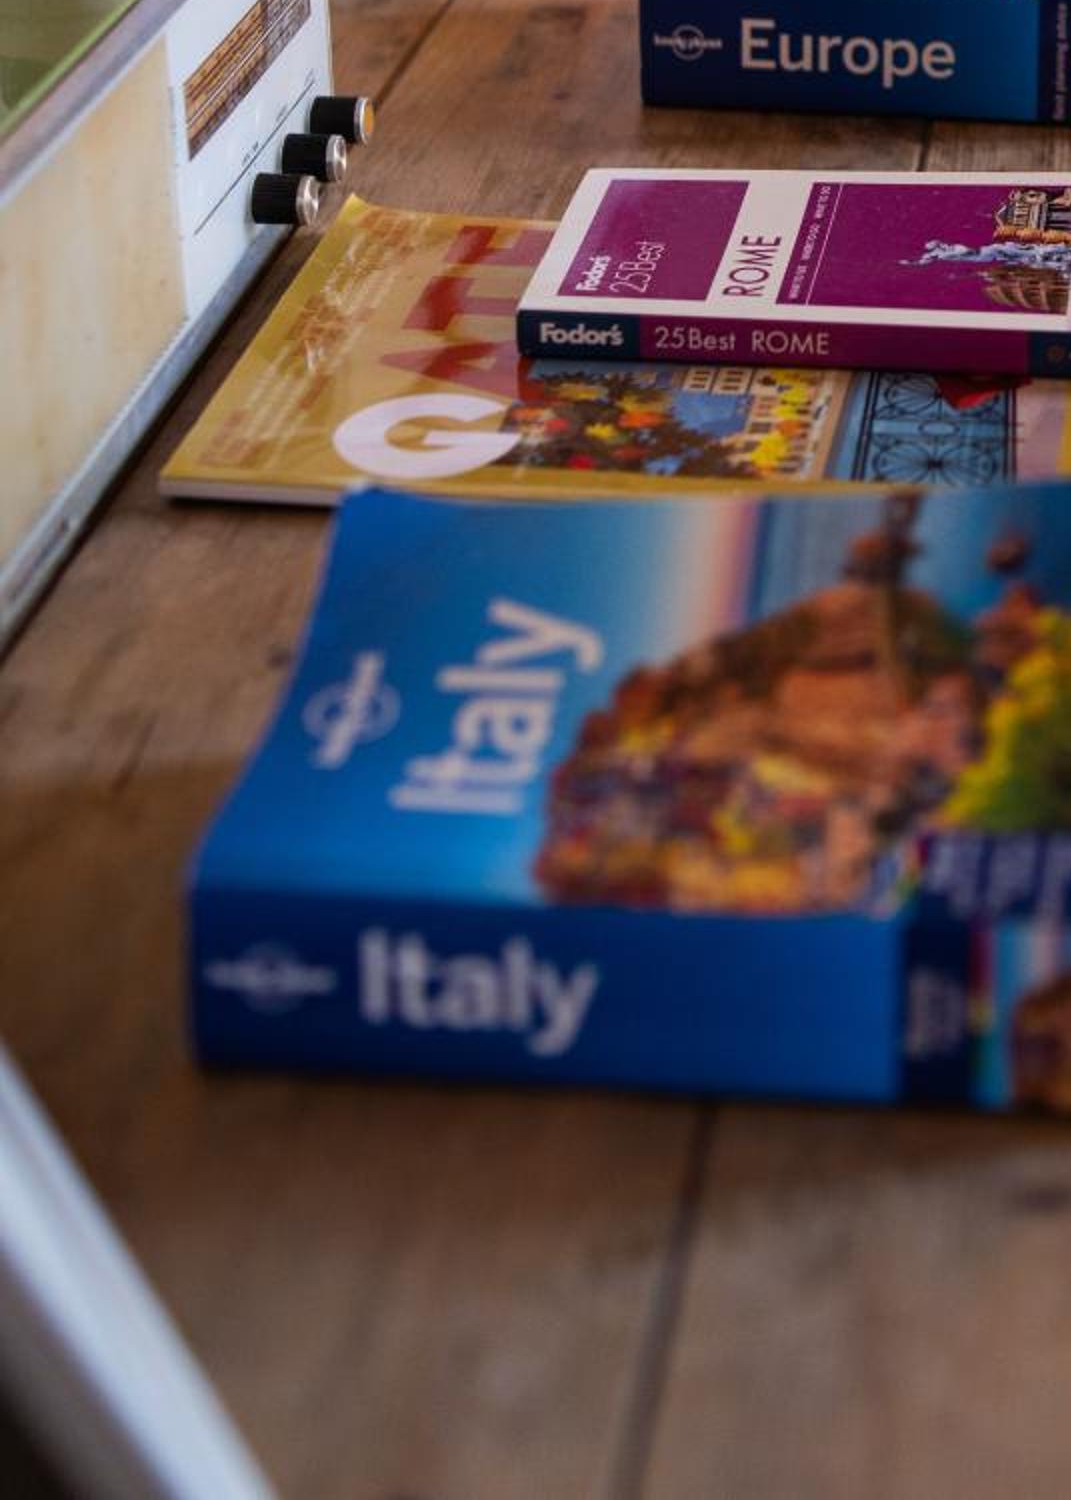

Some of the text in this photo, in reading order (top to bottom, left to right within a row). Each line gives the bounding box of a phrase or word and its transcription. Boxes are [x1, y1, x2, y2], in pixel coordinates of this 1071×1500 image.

[741, 18, 957, 89] Europe
[575, 254, 612, 291] Fodor's
[609, 241, 667, 293] 25Best
[722, 235, 782, 297] ROME
[540, 322, 831, 355] Fodor's 25Best ROME
[388, 596, 604, 816] Italy
[358, 925, 598, 1056] Italy
